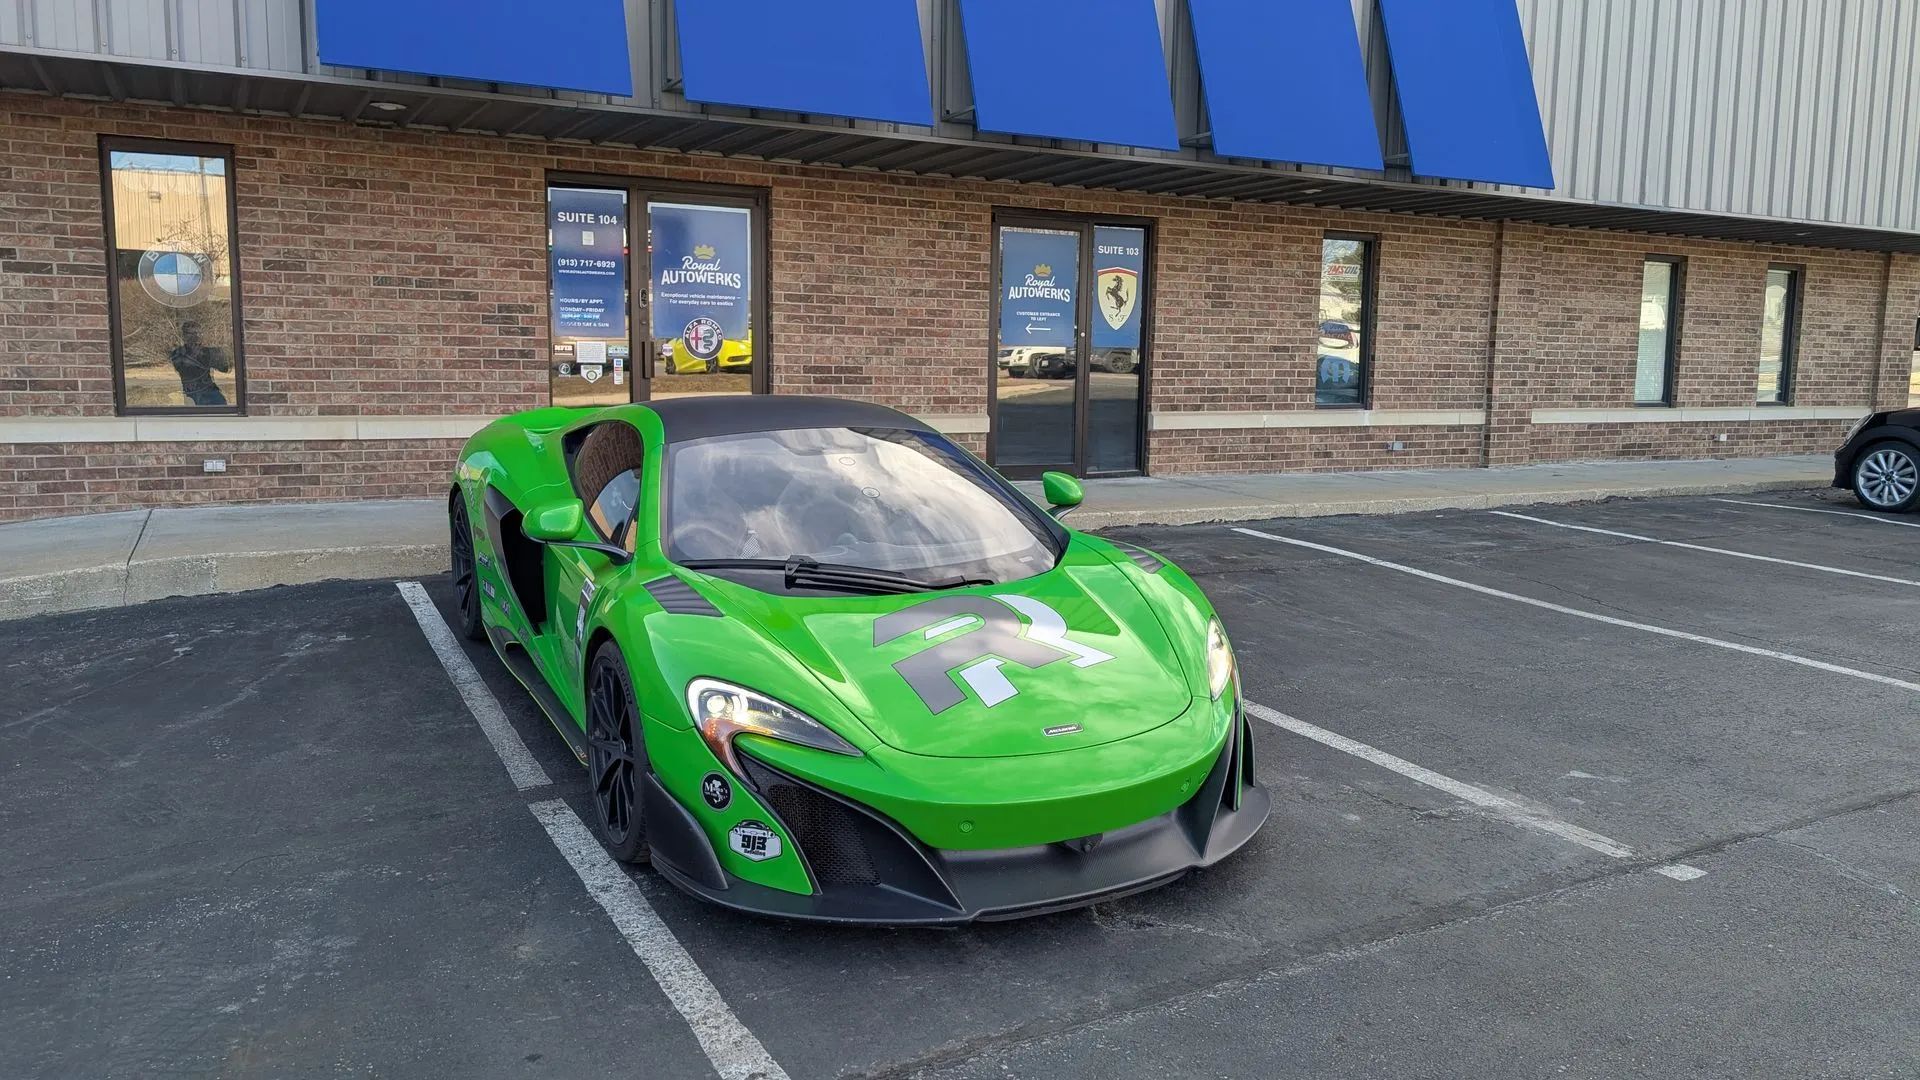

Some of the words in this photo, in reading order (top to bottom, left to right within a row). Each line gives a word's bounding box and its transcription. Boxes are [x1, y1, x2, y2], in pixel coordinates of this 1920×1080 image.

[558, 212, 595, 224] SUITE
[598, 215, 618, 224] 104
[146, 242, 208, 266] BMW
[1098, 245, 1124, 254] SUITE
[1126, 248, 1139, 256] 103
[558, 258, 578, 267] (913)
[580, 260, 616, 268] 717-6929
[682, 256, 721, 276] Royal
[661, 270, 741, 289] AUTOWERKS
[1025, 274, 1056, 291] Royal
[1008, 286, 1071, 302] AUTOWERKS
[685, 322, 698, 338] ALFA
[701, 320, 722, 340] ROMEO
[741, 834, 767, 851] 913
